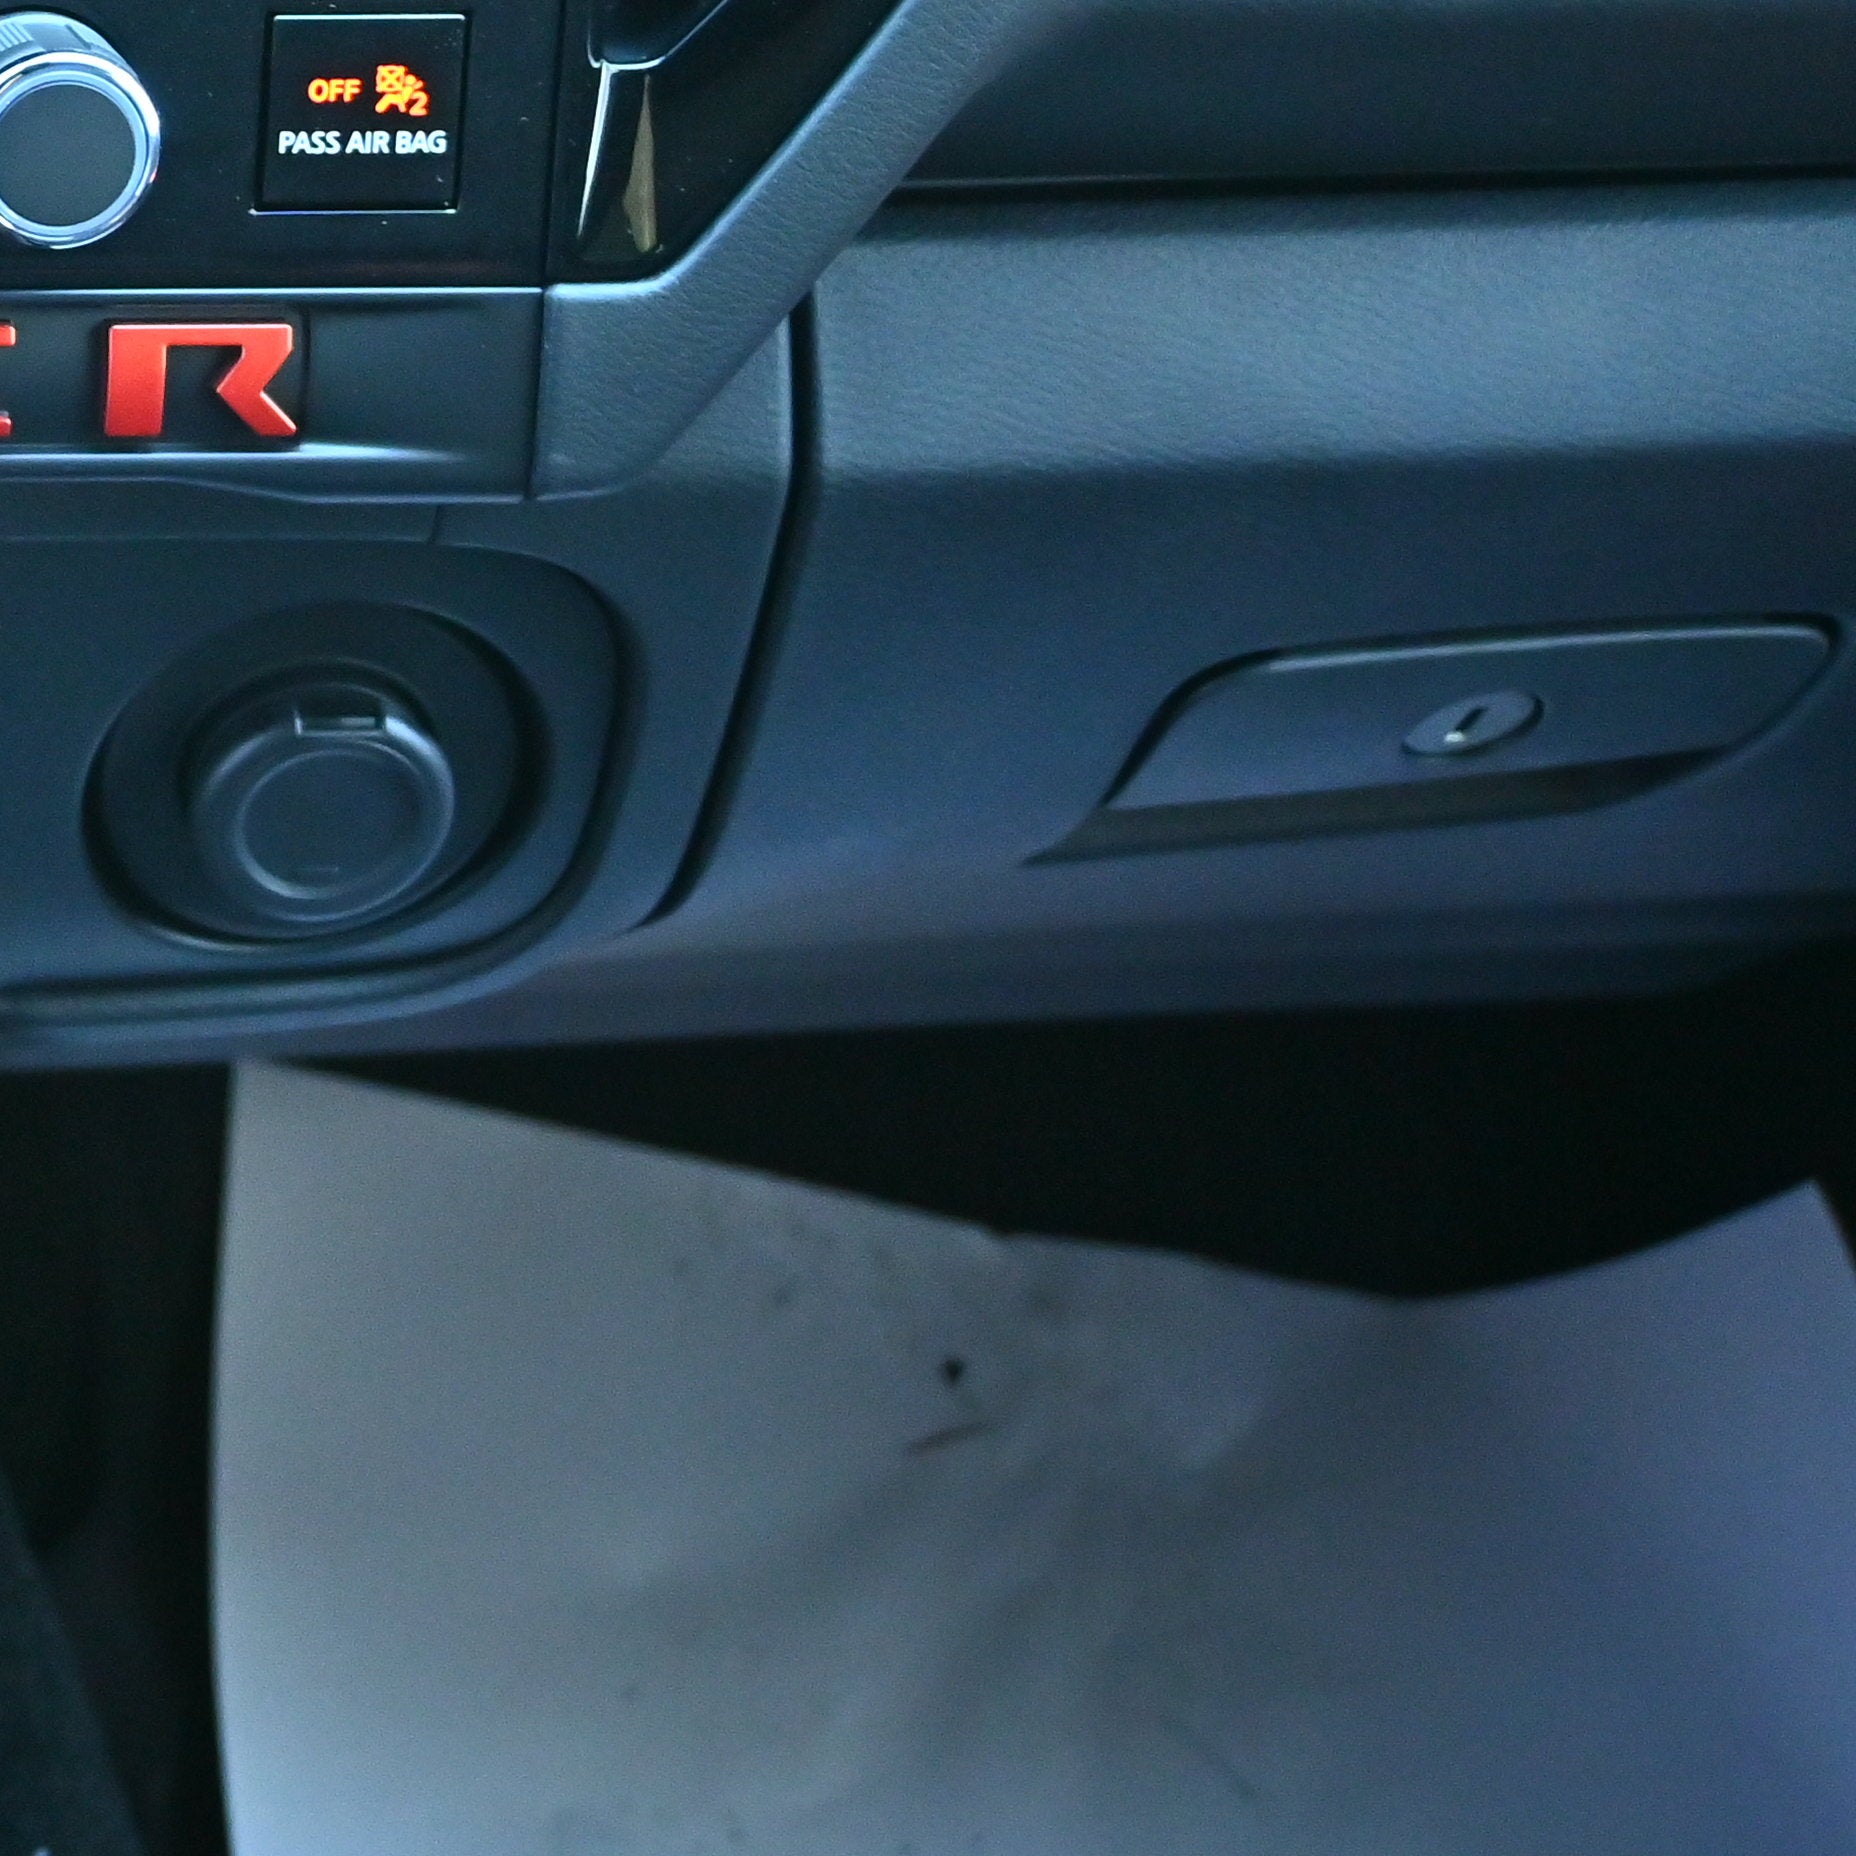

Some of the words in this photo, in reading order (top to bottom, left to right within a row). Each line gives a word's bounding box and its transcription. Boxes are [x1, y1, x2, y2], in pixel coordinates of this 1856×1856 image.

[307, 77, 363, 104] OFF
[278, 130, 342, 155] PASS
[344, 130, 391, 155] AIR
[394, 129, 448, 155] BAG
